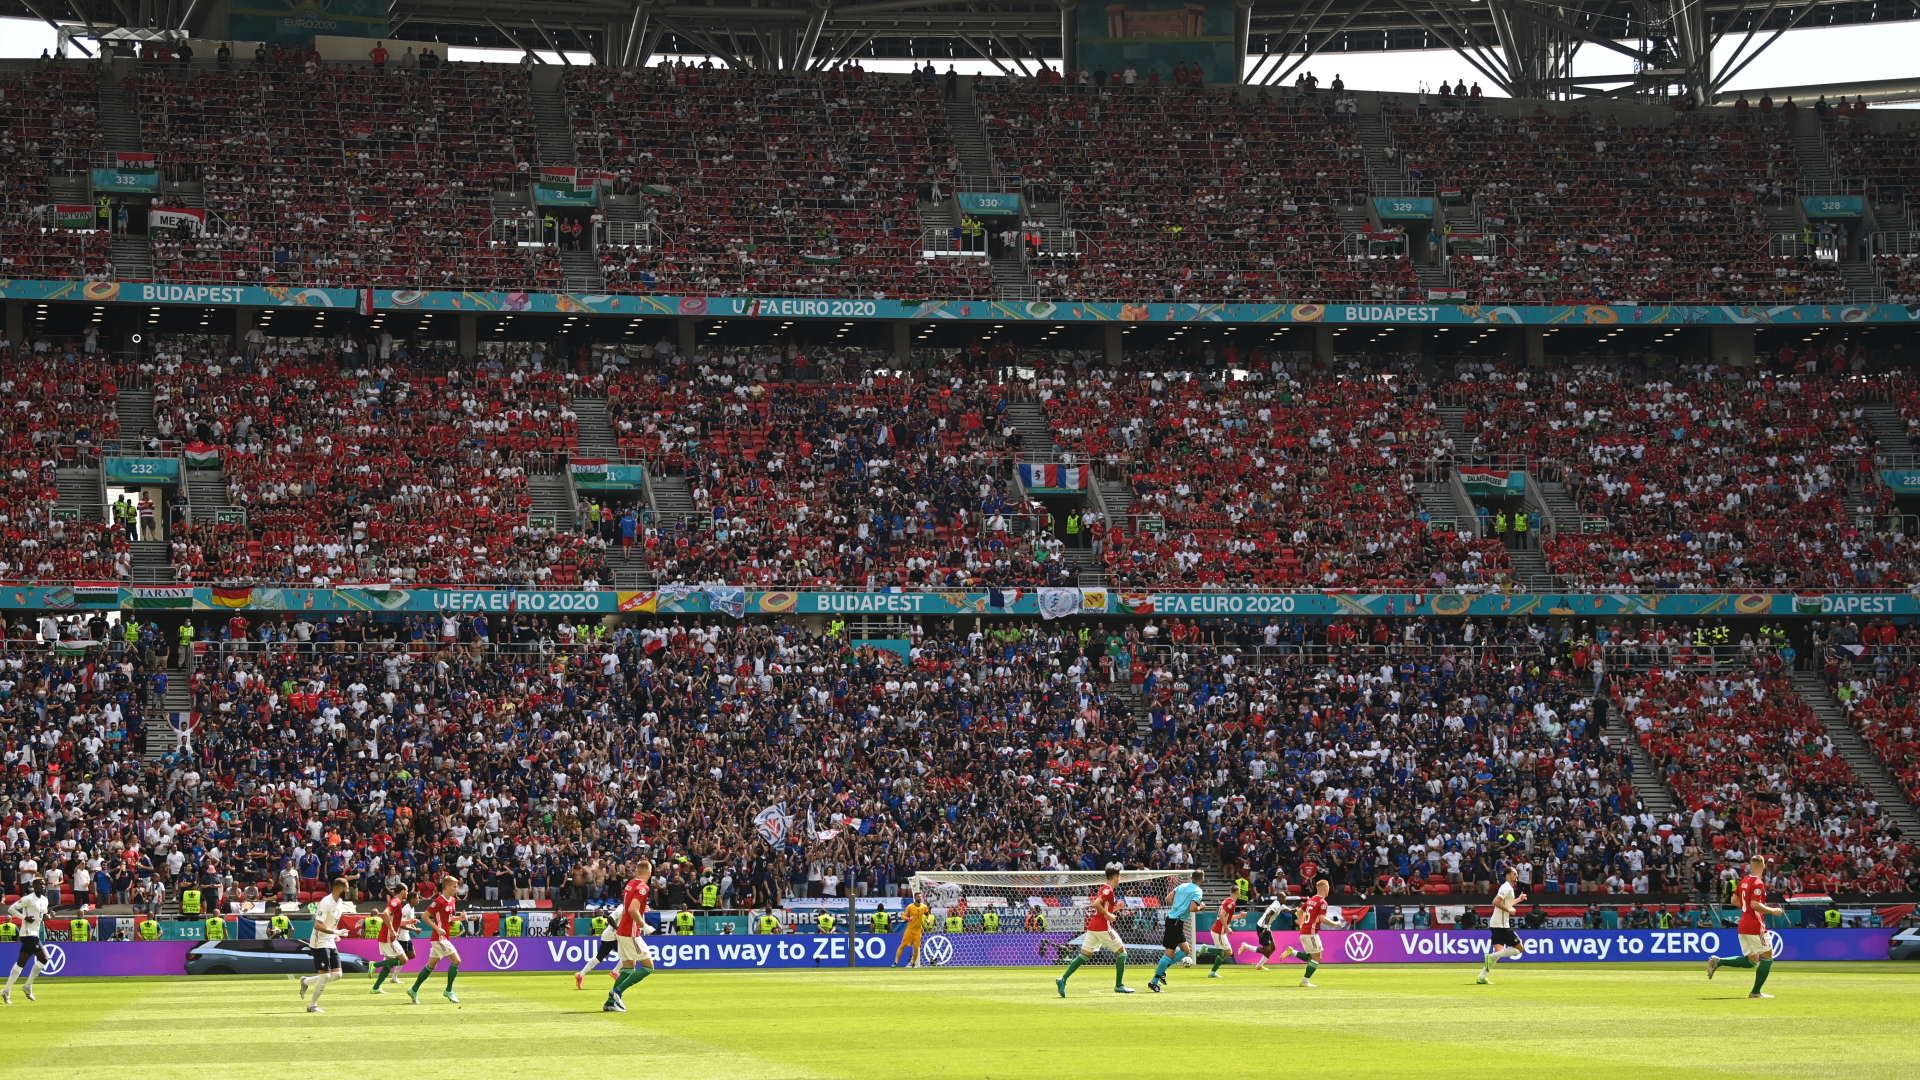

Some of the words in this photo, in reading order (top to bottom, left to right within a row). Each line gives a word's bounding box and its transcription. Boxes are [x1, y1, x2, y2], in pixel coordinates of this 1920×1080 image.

[123, 160, 149, 169] KAL
[116, 176, 135, 185] 332
[545, 174, 570, 183] TAPOLCA
[979, 199, 998, 207] 330
[1393, 203, 1412, 211] 329
[1822, 202, 1840, 210] 328
[58, 211, 91, 220] HATVAN
[143, 285, 244, 302] BUDAPEST
[732, 300, 779, 314] UFA
[781, 300, 829, 315] EURO
[831, 301, 876, 316] 2020
[1345, 306, 1440, 321] BUDAPEST
[131, 464, 153, 474] 232
[1466, 474, 1502, 486] ZALAEGRSZEG
[138, 588, 188, 598] TARANY
[433, 593, 487, 610] UEFA
[550, 593, 599, 610] 2020
[817, 594, 924, 611] BUDAPEST
[1154, 596, 1188, 612] EFA
[1191, 596, 1243, 612] EURO
[1246, 596, 1295, 612] 2020
[1792, 596, 1896, 612] DAPEST
[782, 908, 907, 925] IRRÉISTIBES
[1229, 918, 1247, 927] 29
[180, 927, 201, 937] 131
[923, 935, 953, 966] VW
[1345, 931, 1374, 961] VW
[1400, 932, 1554, 961] Volkswen
[1560, 936, 1612, 960] way
[1616, 934, 1644, 955] to
[1650, 931, 1720, 954] ZERO
[488, 939, 519, 970] VW
[547, 939, 709, 967] Volksagen
[717, 943, 772, 966] way
[777, 940, 806, 960] to
[813, 936, 886, 959] ZERO
